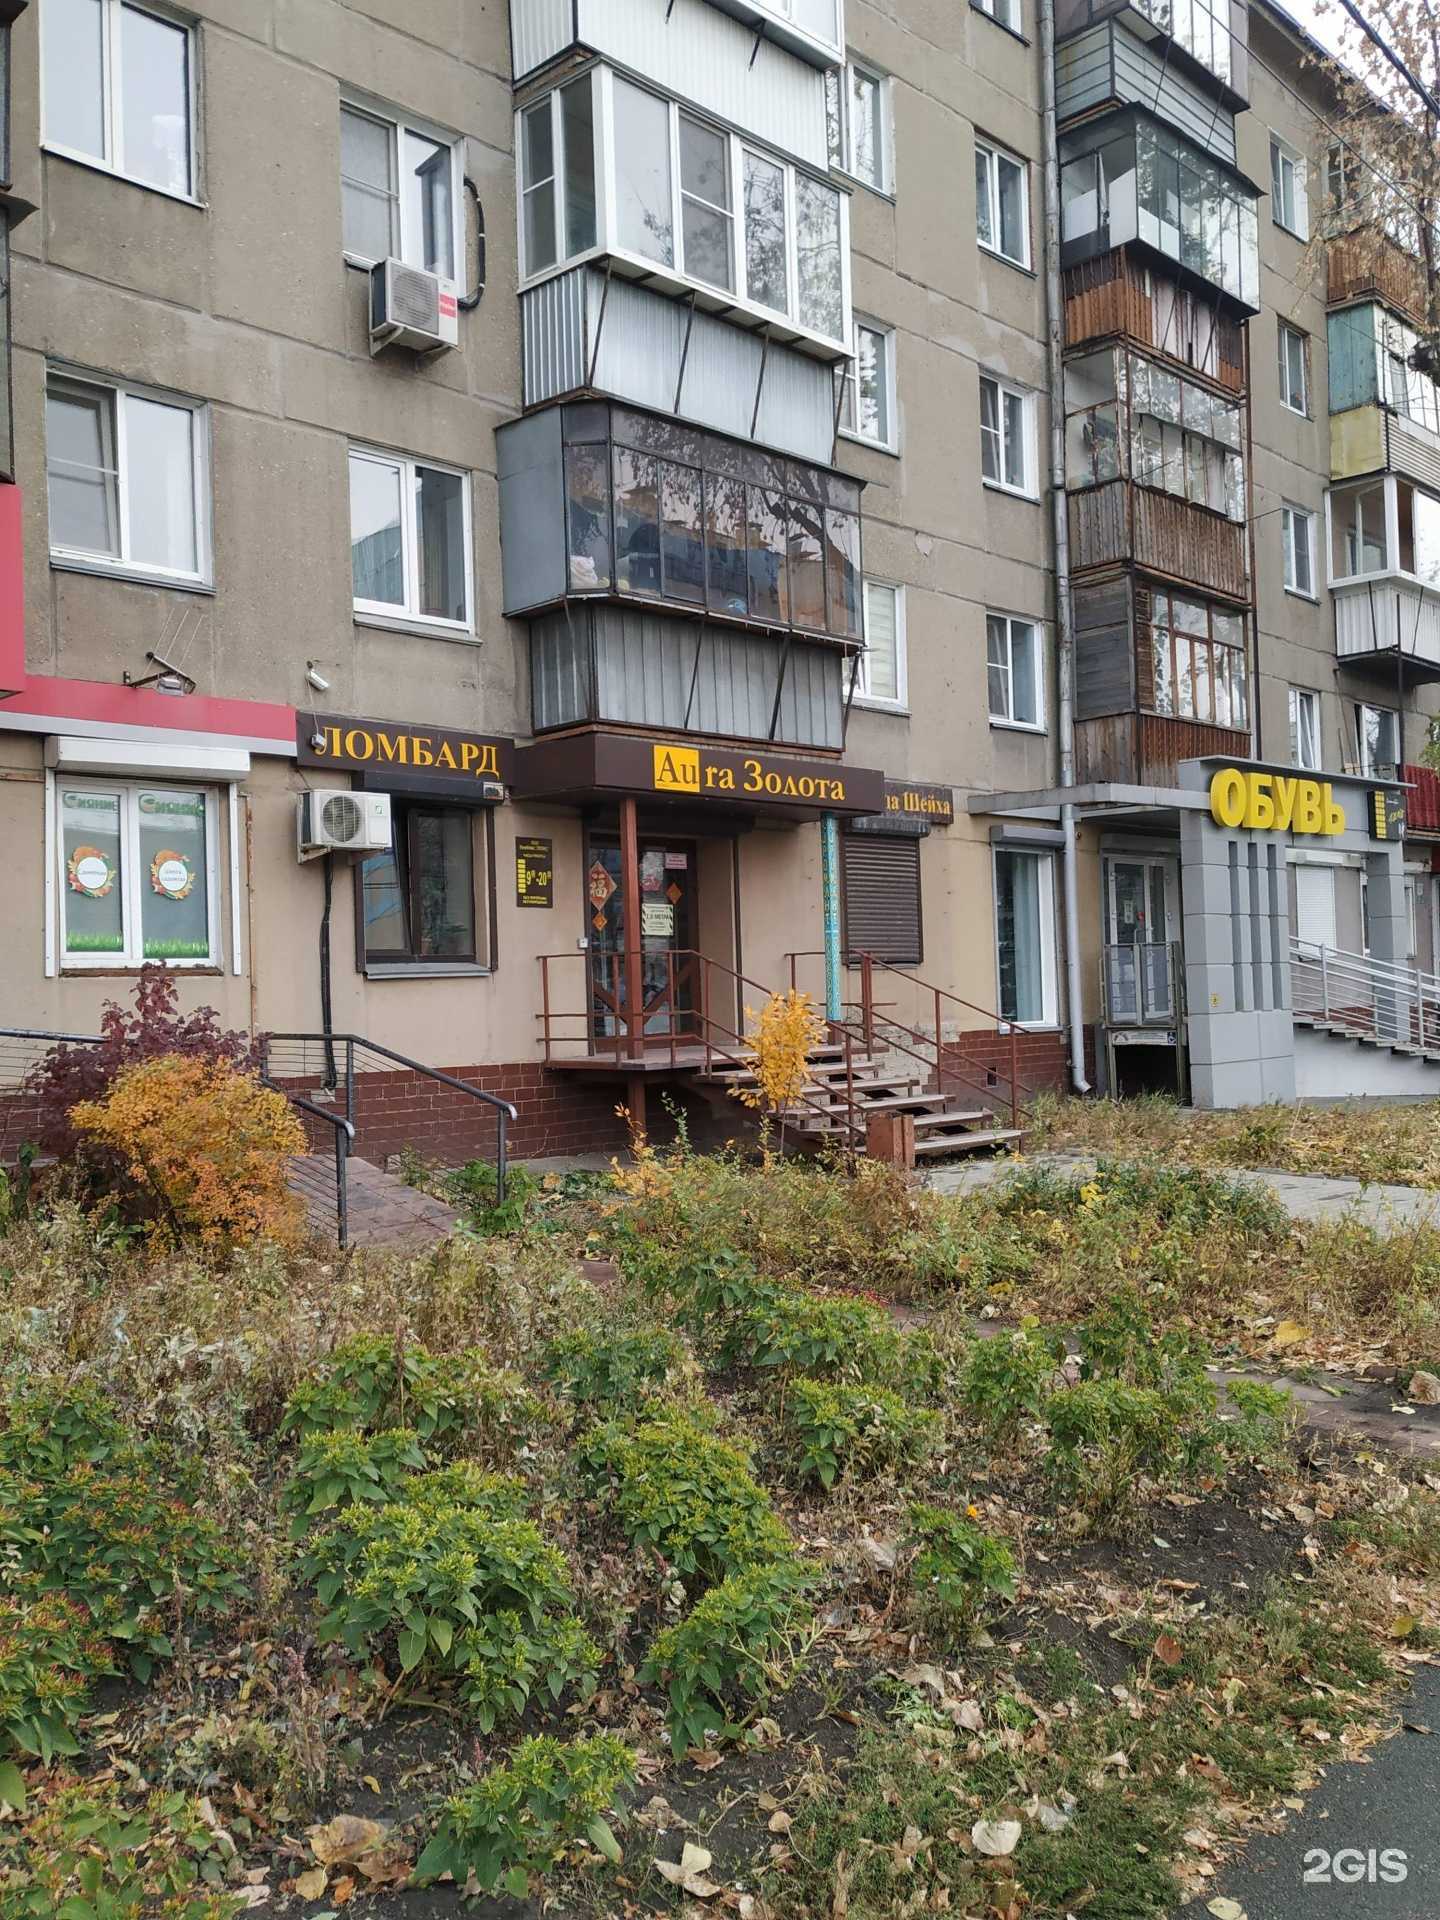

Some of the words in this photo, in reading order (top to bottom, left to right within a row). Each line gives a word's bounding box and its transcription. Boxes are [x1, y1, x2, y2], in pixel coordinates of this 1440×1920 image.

[315, 726, 500, 779] ЛОМБАРД
[743, 759, 846, 801] Золота
[903, 791, 951, 815] Шейха
[1210, 768, 1345, 836] ОБУВЬ
